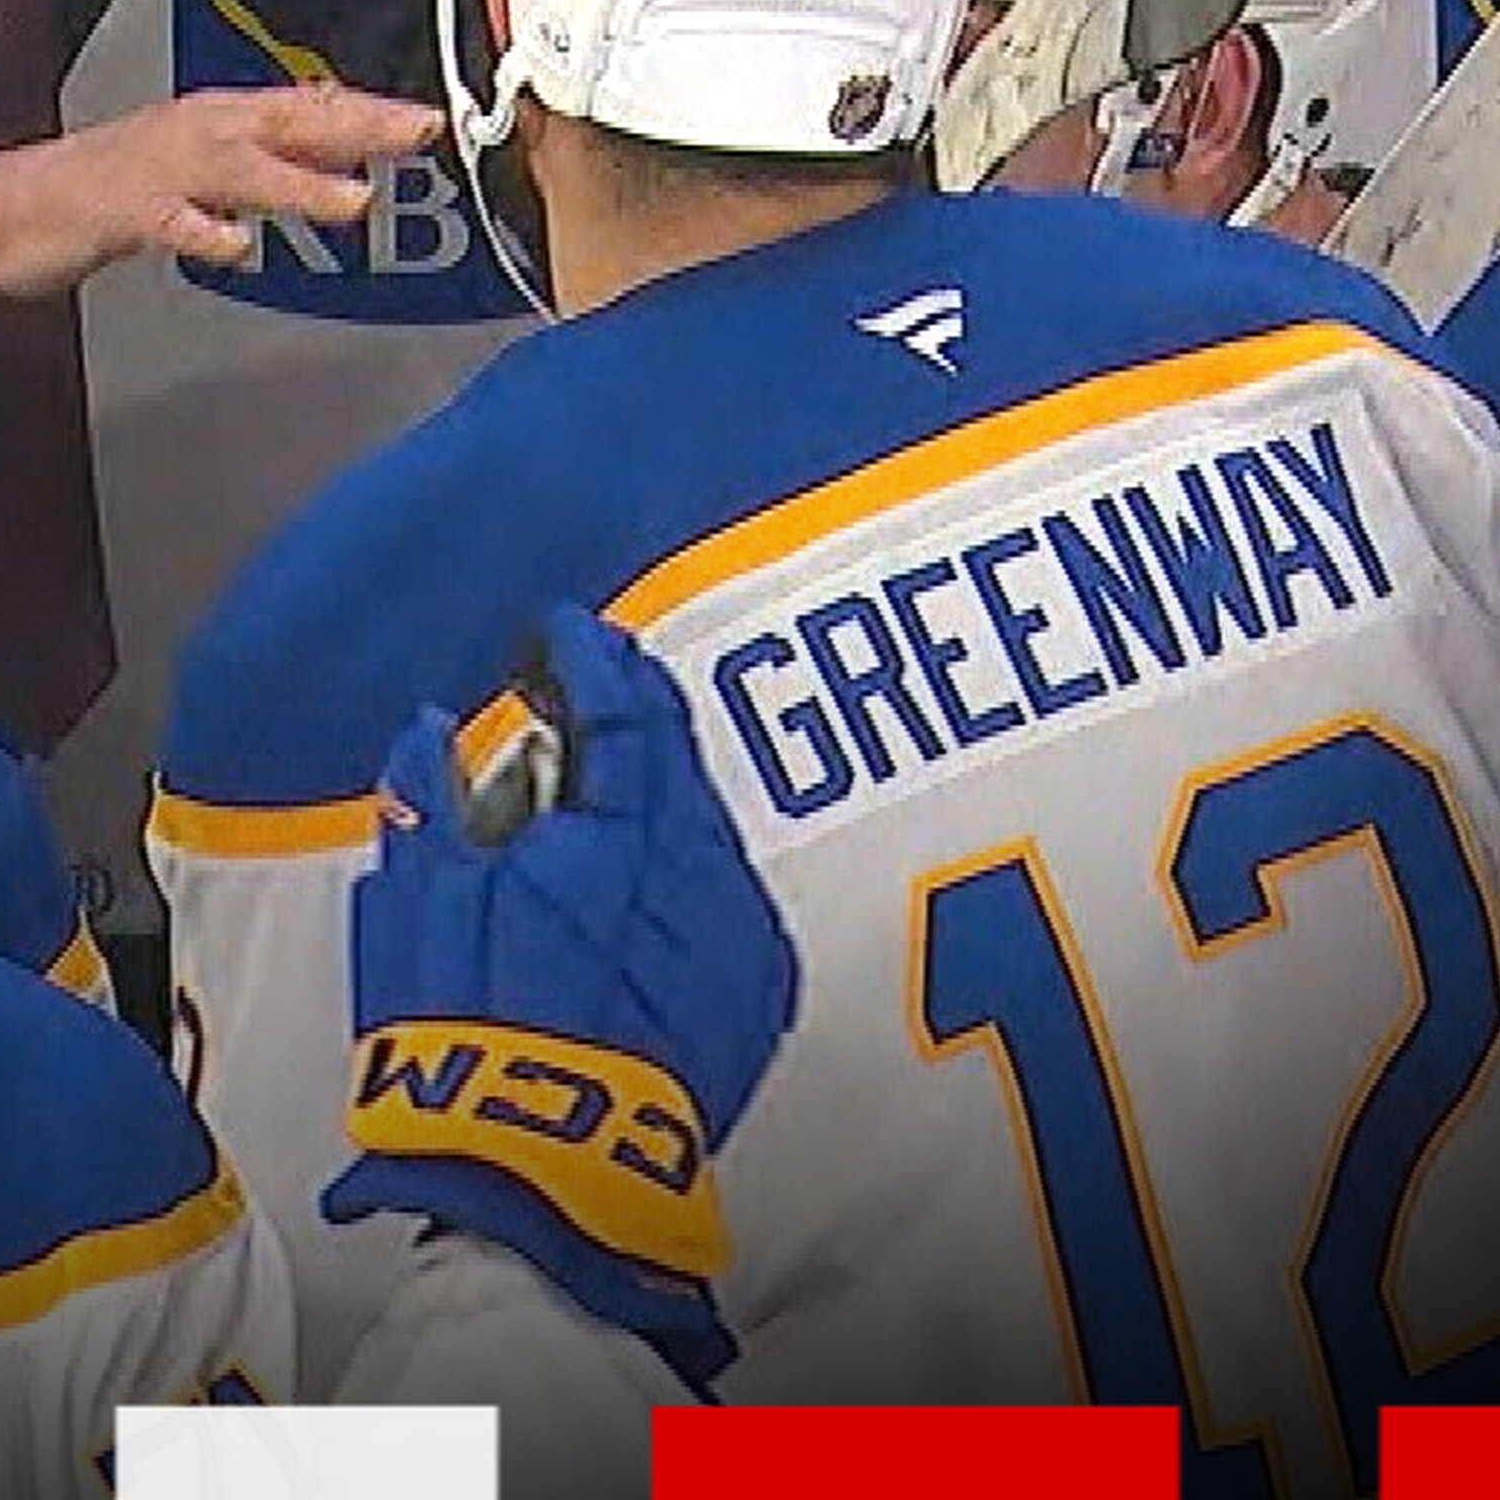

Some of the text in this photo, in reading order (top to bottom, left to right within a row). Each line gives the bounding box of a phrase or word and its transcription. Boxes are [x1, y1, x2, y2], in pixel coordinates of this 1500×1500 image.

[711, 421, 1394, 820] GREENWAY
[354, 1037, 700, 1196] CCM
[904, 706, 1500, 1500] 12
